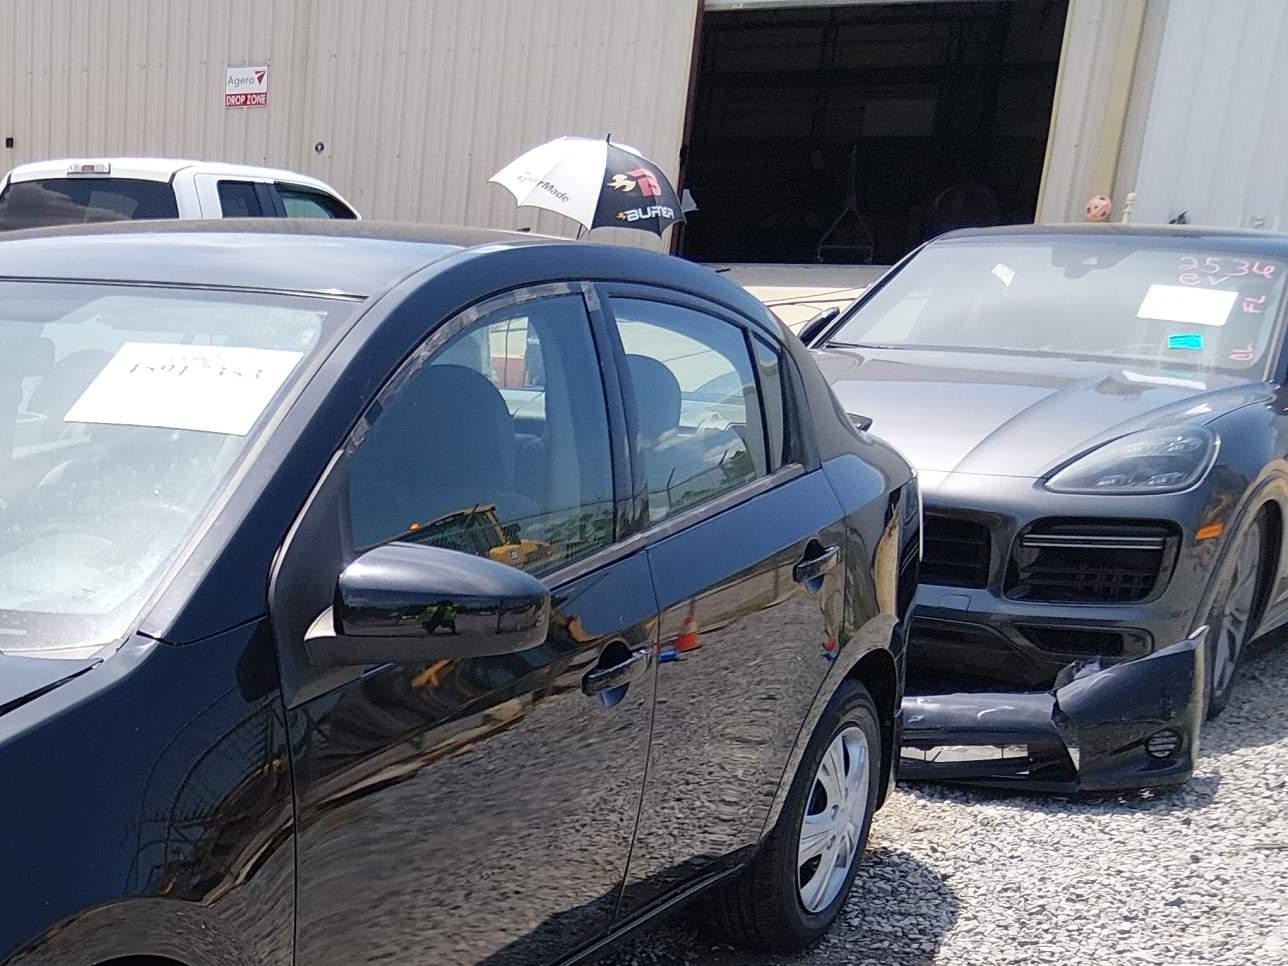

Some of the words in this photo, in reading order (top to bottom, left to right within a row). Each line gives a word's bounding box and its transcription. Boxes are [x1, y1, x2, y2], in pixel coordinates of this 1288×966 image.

[227, 76, 255, 87] Agero
[226, 95, 246, 105] DROP
[246, 94, 266, 104] ZONE
